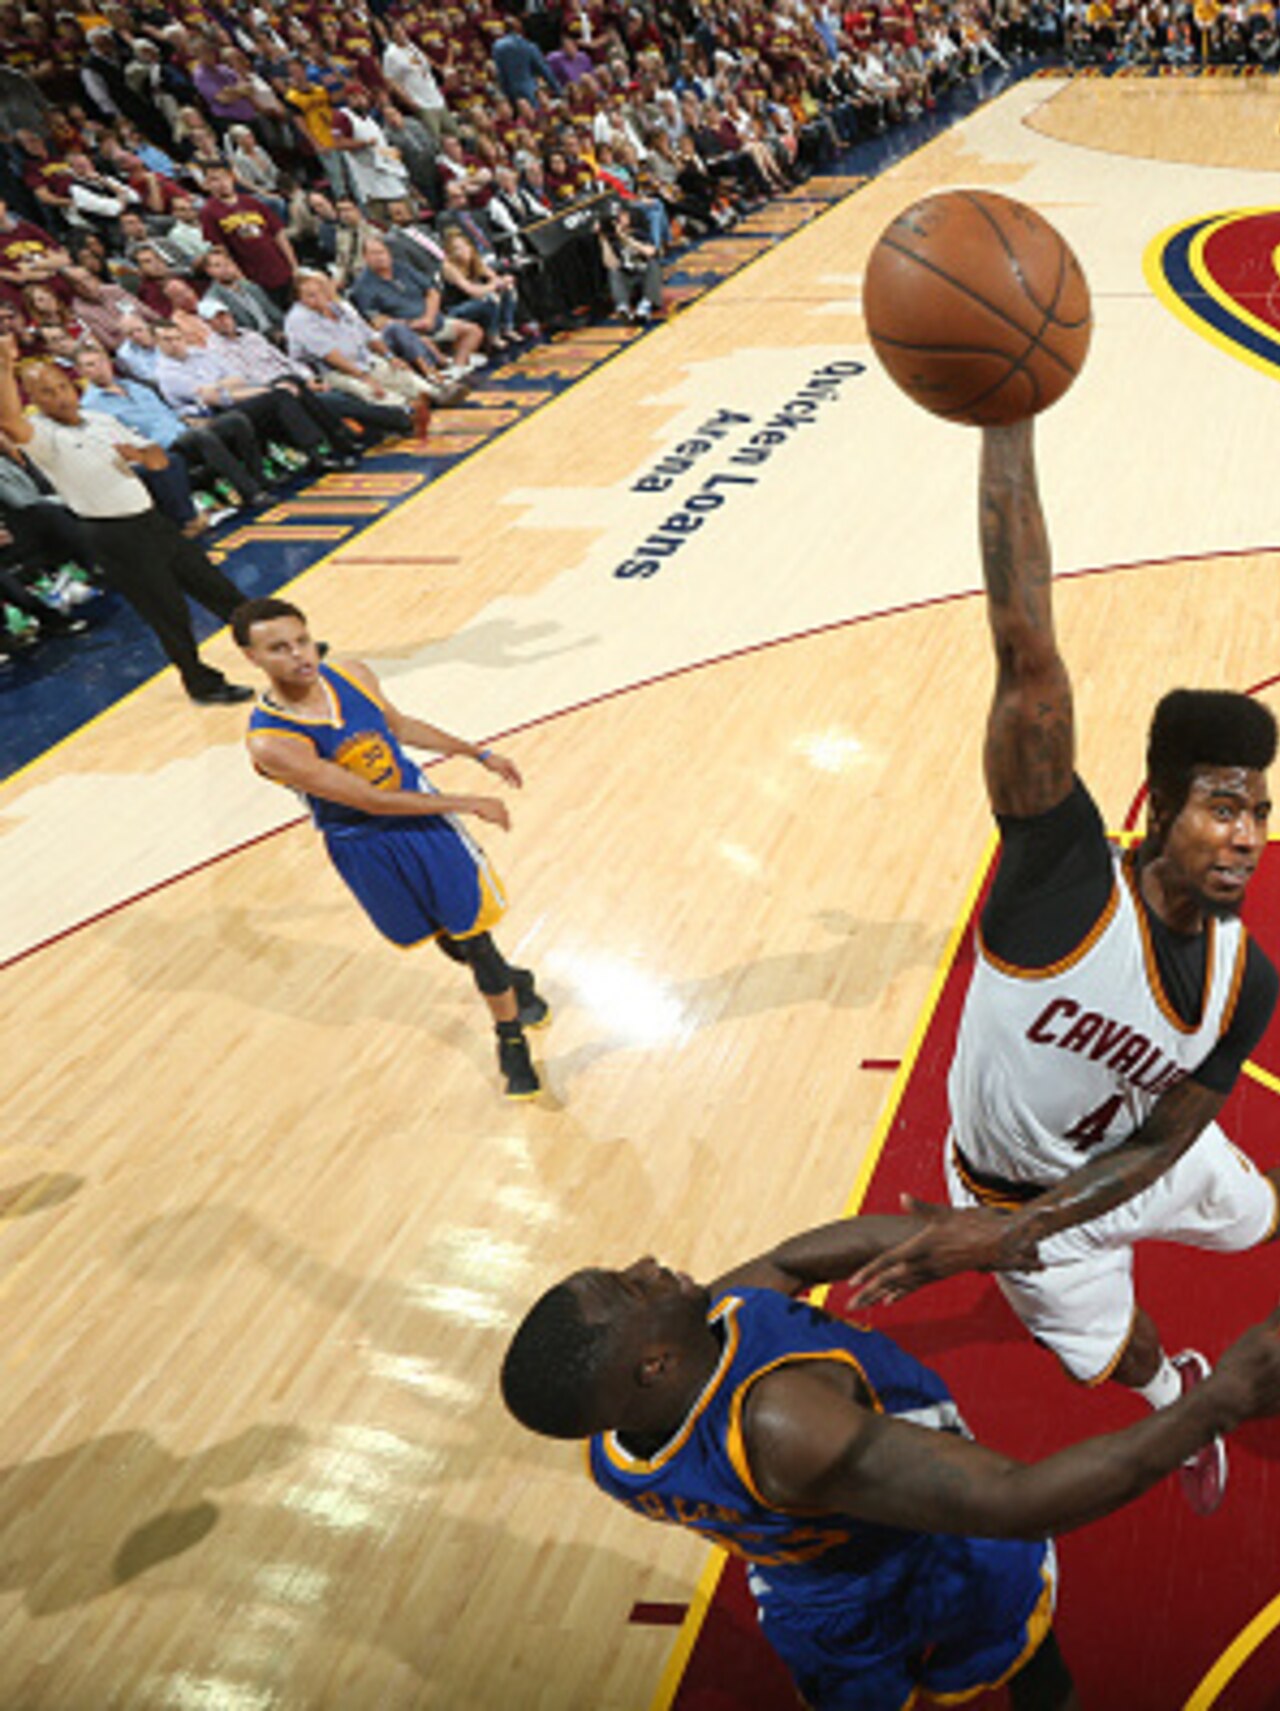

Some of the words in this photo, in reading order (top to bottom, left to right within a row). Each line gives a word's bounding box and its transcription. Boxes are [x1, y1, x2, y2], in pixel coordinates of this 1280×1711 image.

[630, 408, 752, 493] Arena
[729, 361, 868, 466] Quicken
[613, 473, 759, 580] Loans
[1063, 1093, 1125, 1152] 4
